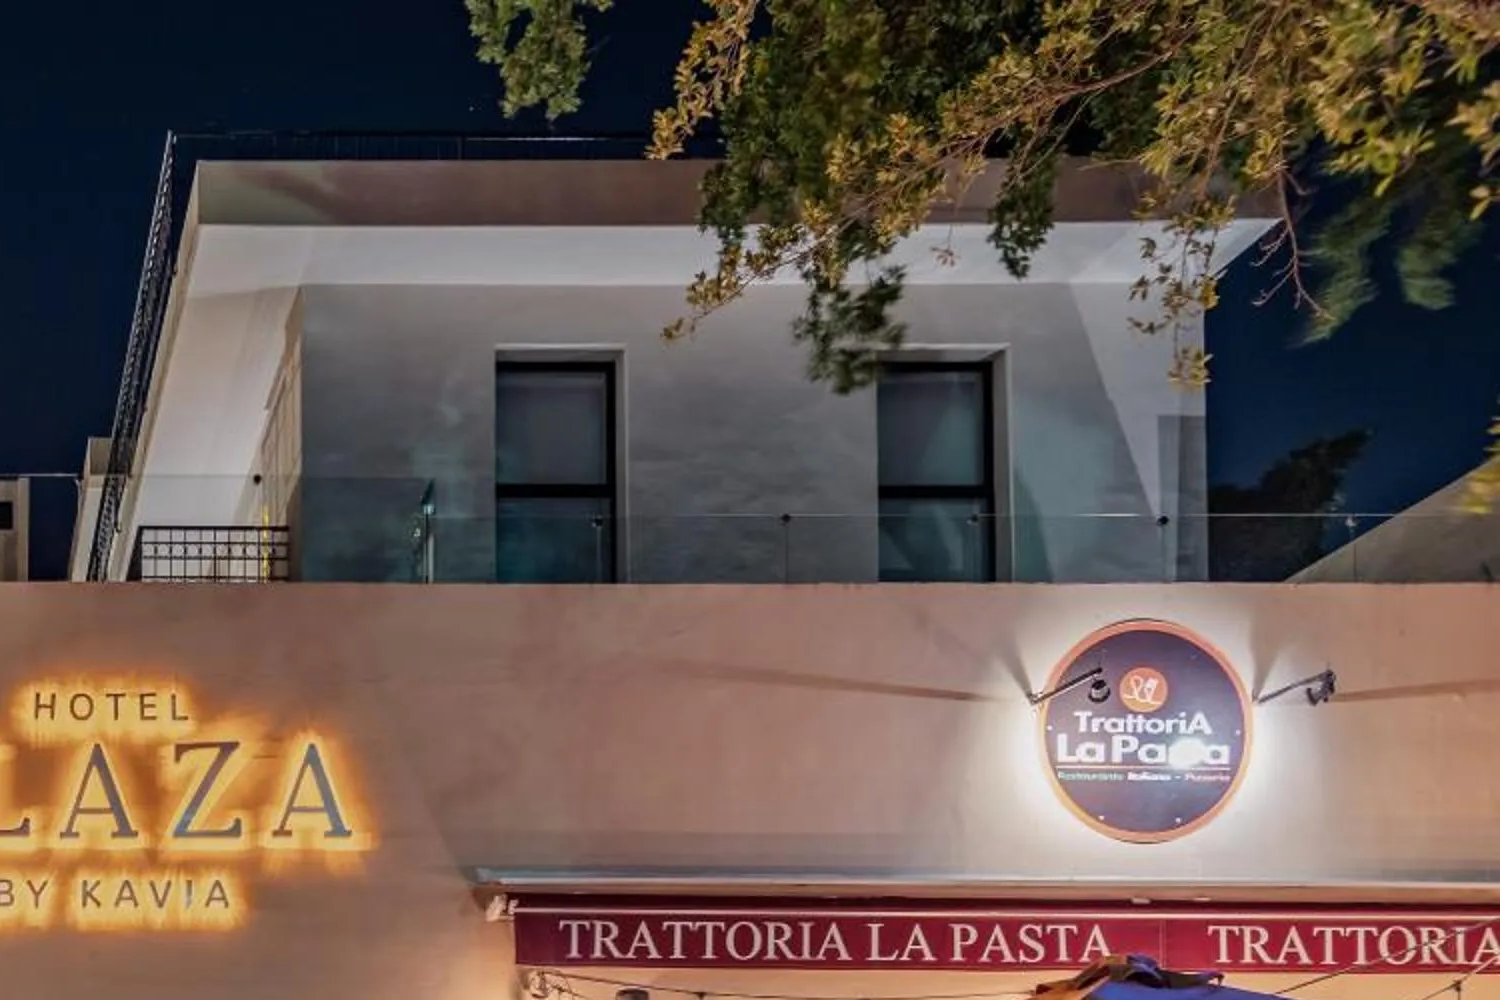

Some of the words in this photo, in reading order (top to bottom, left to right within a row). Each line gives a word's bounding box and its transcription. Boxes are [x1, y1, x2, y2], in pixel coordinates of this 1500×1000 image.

[33, 693, 189, 722] HOTEL
[1111, 734, 1231, 765] Paa
[80, 879, 230, 910] KAVIA
[558, 920, 853, 961] TRATTORIA
[865, 923, 938, 962] LA
[949, 923, 1113, 963] PASTA
[1207, 925, 1500, 966] TRATTORIA
